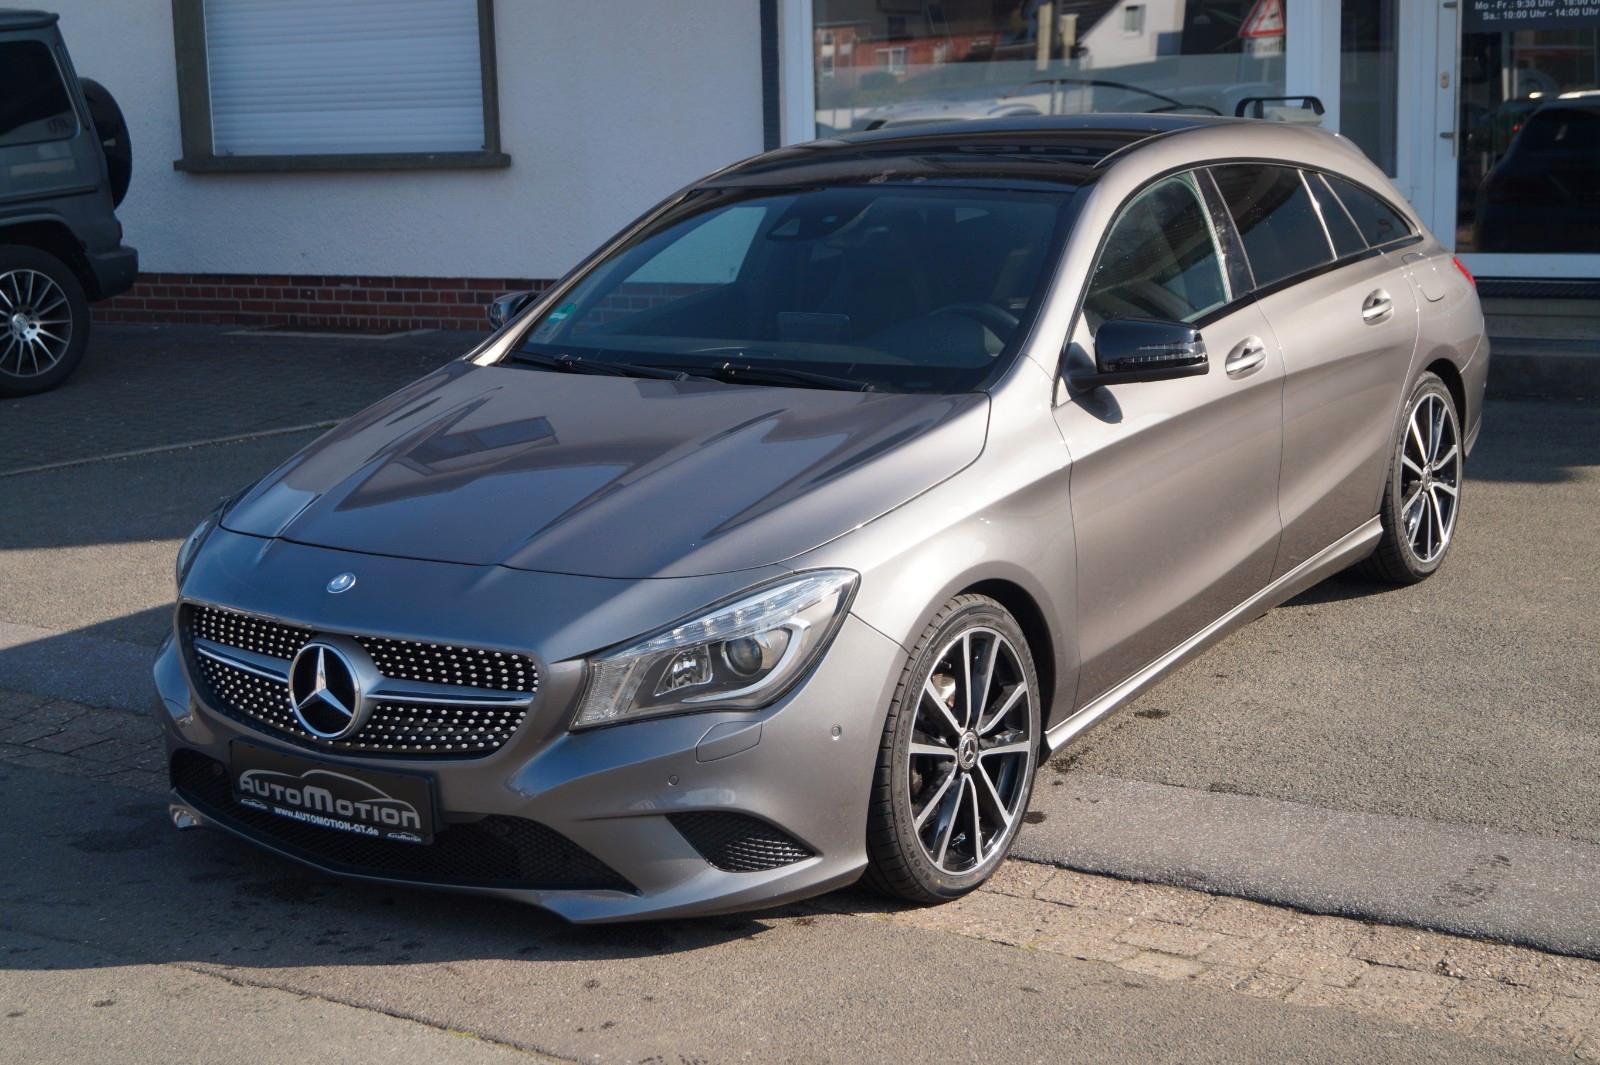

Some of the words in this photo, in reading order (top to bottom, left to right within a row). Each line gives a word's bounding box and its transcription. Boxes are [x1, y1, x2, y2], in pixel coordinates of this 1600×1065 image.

[1475, 1, 1489, 10] Mo
[1516, 0, 1536, 9] 9:30
[1538, 0, 1555, 8] Uhr
[1483, 11, 1501, 21] Sa.:
[1503, 10, 1527, 20] 10:00
[1529, 9, 1547, 18] Uhr
[1556, 8, 1580, 17] 14:00
[1582, 7, 1599, 16] Uhr
